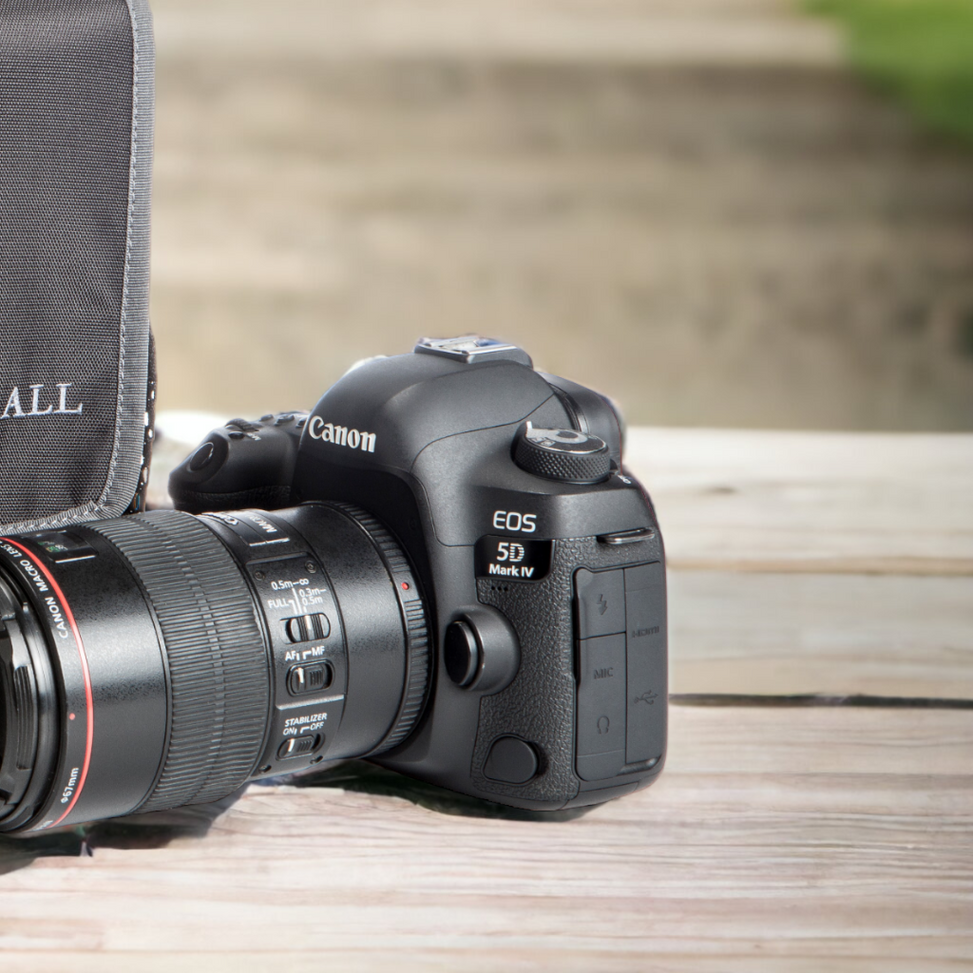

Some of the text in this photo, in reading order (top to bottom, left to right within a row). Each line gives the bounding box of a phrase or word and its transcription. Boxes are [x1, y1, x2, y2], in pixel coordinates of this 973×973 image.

[308, 415, 377, 453] Canon
[492, 510, 537, 533] EOS
[0, 544, 23, 558] LENS
[496, 541, 525, 562] 5D
[20, 559, 49, 592] MACRO
[488, 563, 535, 578] Mark IV
[267, 598, 289, 609] FULL
[301, 596, 324, 606] 0.5m
[45, 596, 68, 639] CANON
[285, 645, 326, 662] AF MF
[593, 667, 614, 680] MIC
[284, 712, 328, 728] STABILIZER
[282, 721, 325, 736] ON OFF
